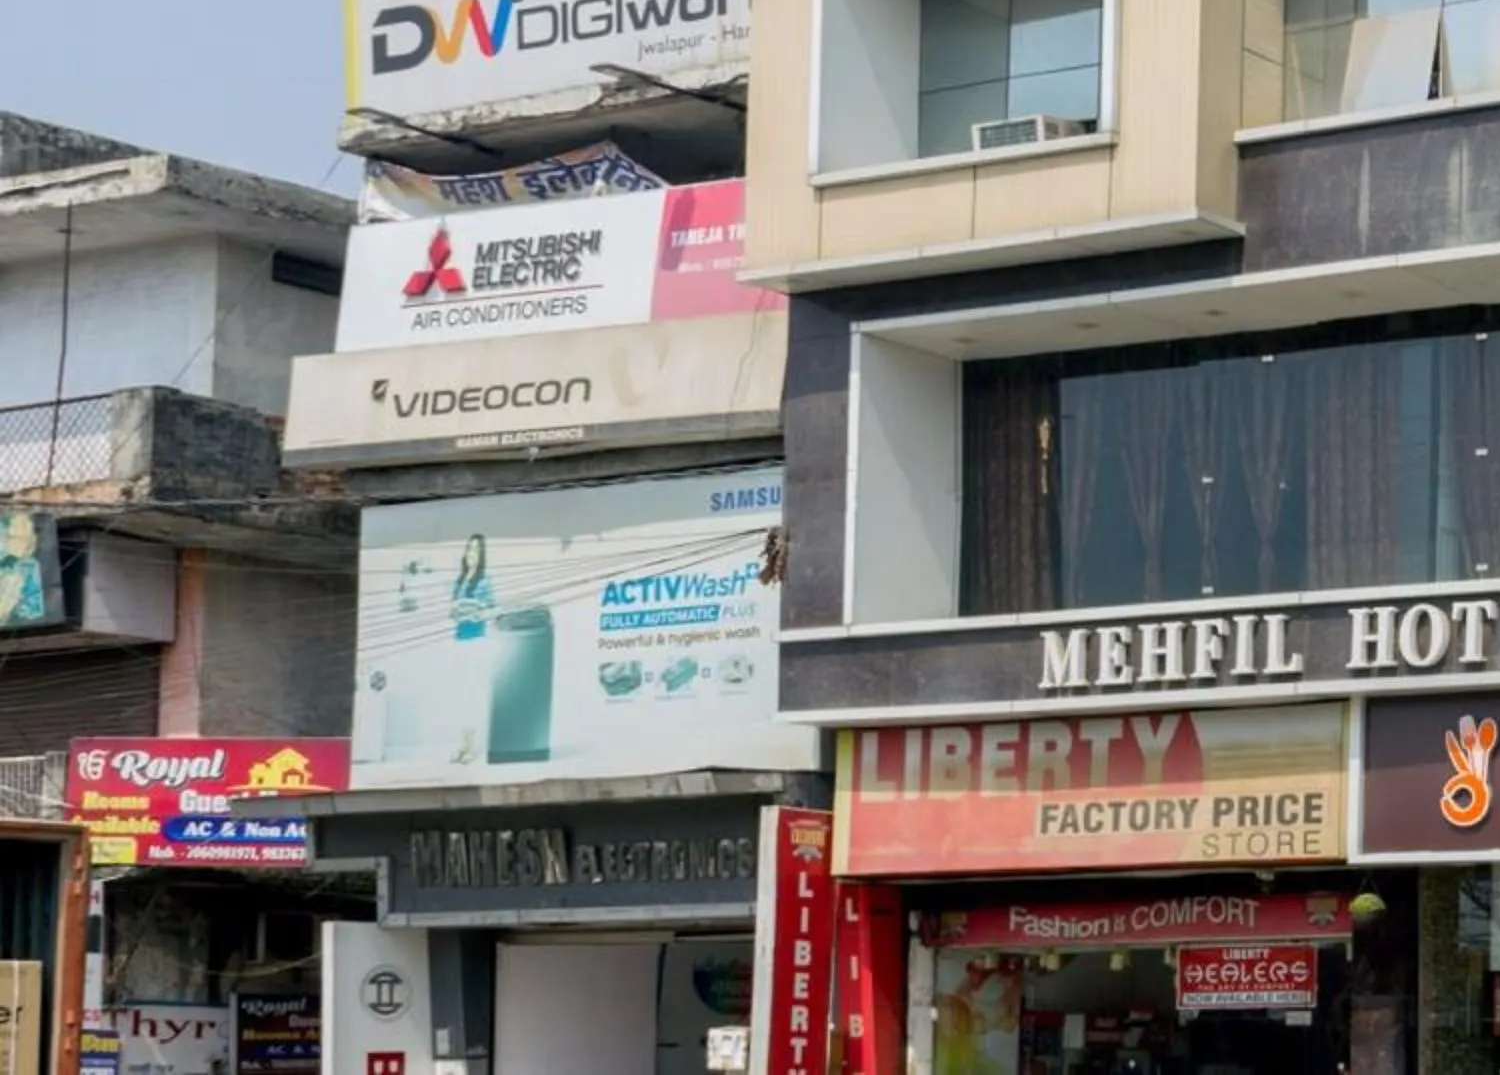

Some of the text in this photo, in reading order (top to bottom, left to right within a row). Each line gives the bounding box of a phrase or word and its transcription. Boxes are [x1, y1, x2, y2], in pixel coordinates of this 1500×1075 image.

[475, 228, 603, 262] MITSUBISHI
[471, 256, 584, 291] ELECTRIC
[411, 294, 588, 331] AIR CONDITIONERS
[393, 376, 592, 419] VIDEOCON
[710, 487, 781, 512] SAMSU
[601, 612, 642, 628] FULLY
[644, 608, 715, 625] AUTOMATIC
[598, 633, 653, 649] Powerful
[668, 628, 721, 647] hygienic
[724, 624, 762, 639] wash
[1038, 614, 1304, 691] MEHFIL
[111, 748, 228, 787] Royal
[859, 713, 1184, 803] LIBERTY
[182, 821, 213, 837] AC
[243, 821, 281, 837] Non
[1039, 791, 1325, 835] FACTORY PRICE
[1202, 829, 1324, 861] STORE
[1007, 905, 1110, 939] Fashion
[1130, 895, 1261, 931] COMFORT
[788, 870, 815, 1075] LIBERT
[1183, 960, 1312, 984] HEALERS
